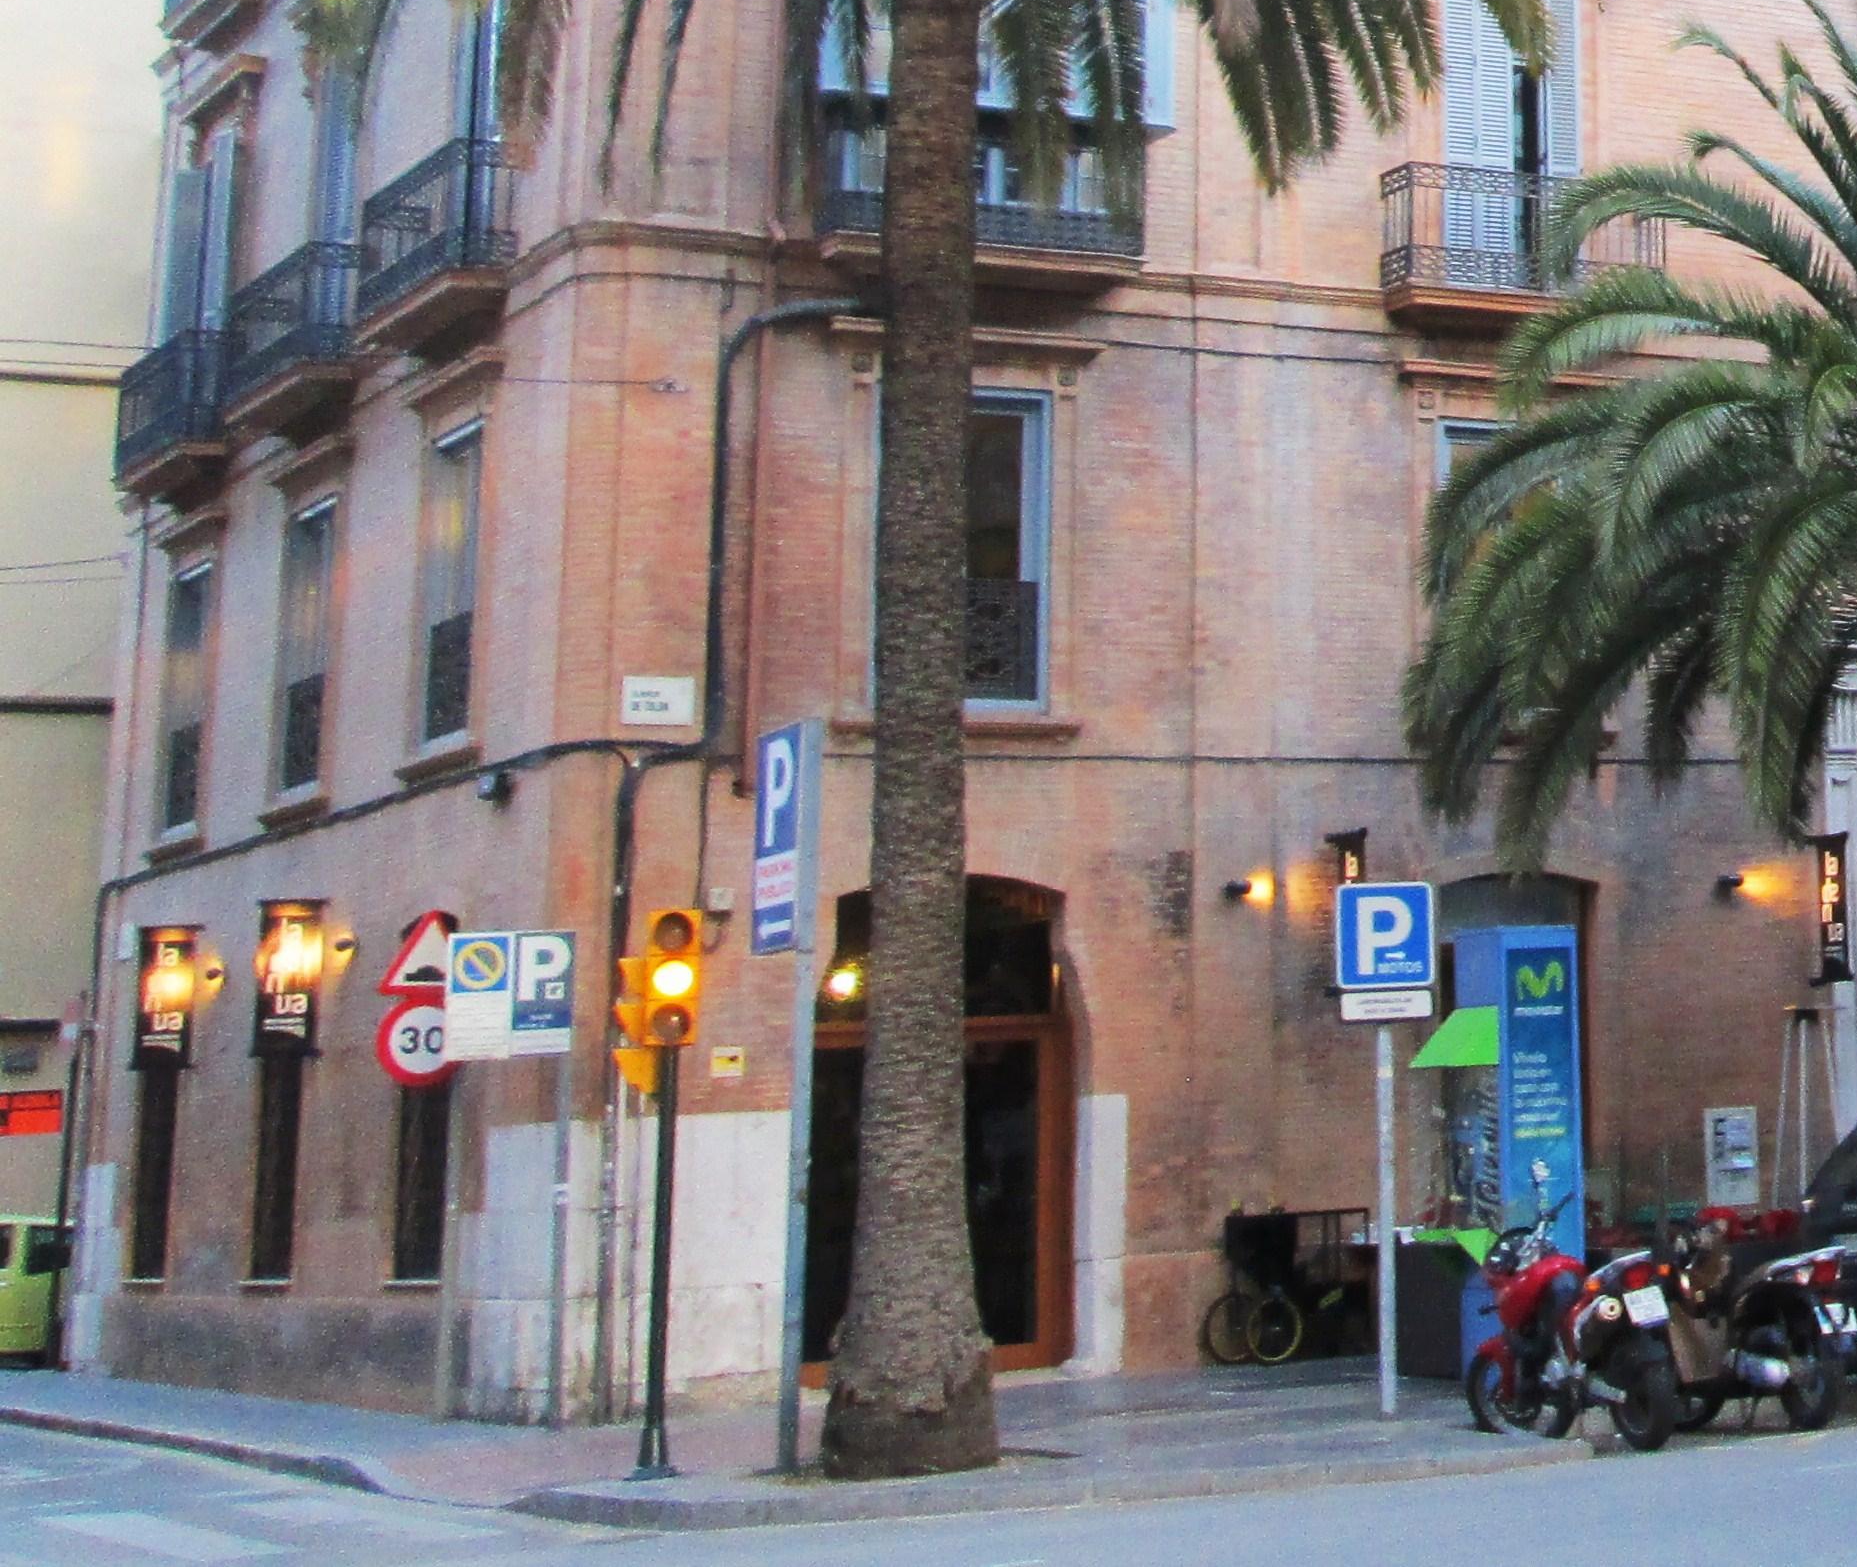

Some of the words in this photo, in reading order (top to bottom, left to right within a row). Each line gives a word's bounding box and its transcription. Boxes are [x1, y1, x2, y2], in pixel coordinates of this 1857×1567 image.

[763, 738, 794, 849] P
[516, 934, 572, 1002] P
[1356, 895, 1414, 976] P
[1377, 960, 1424, 975] MOTOS
[400, 1026, 444, 1054] 30
